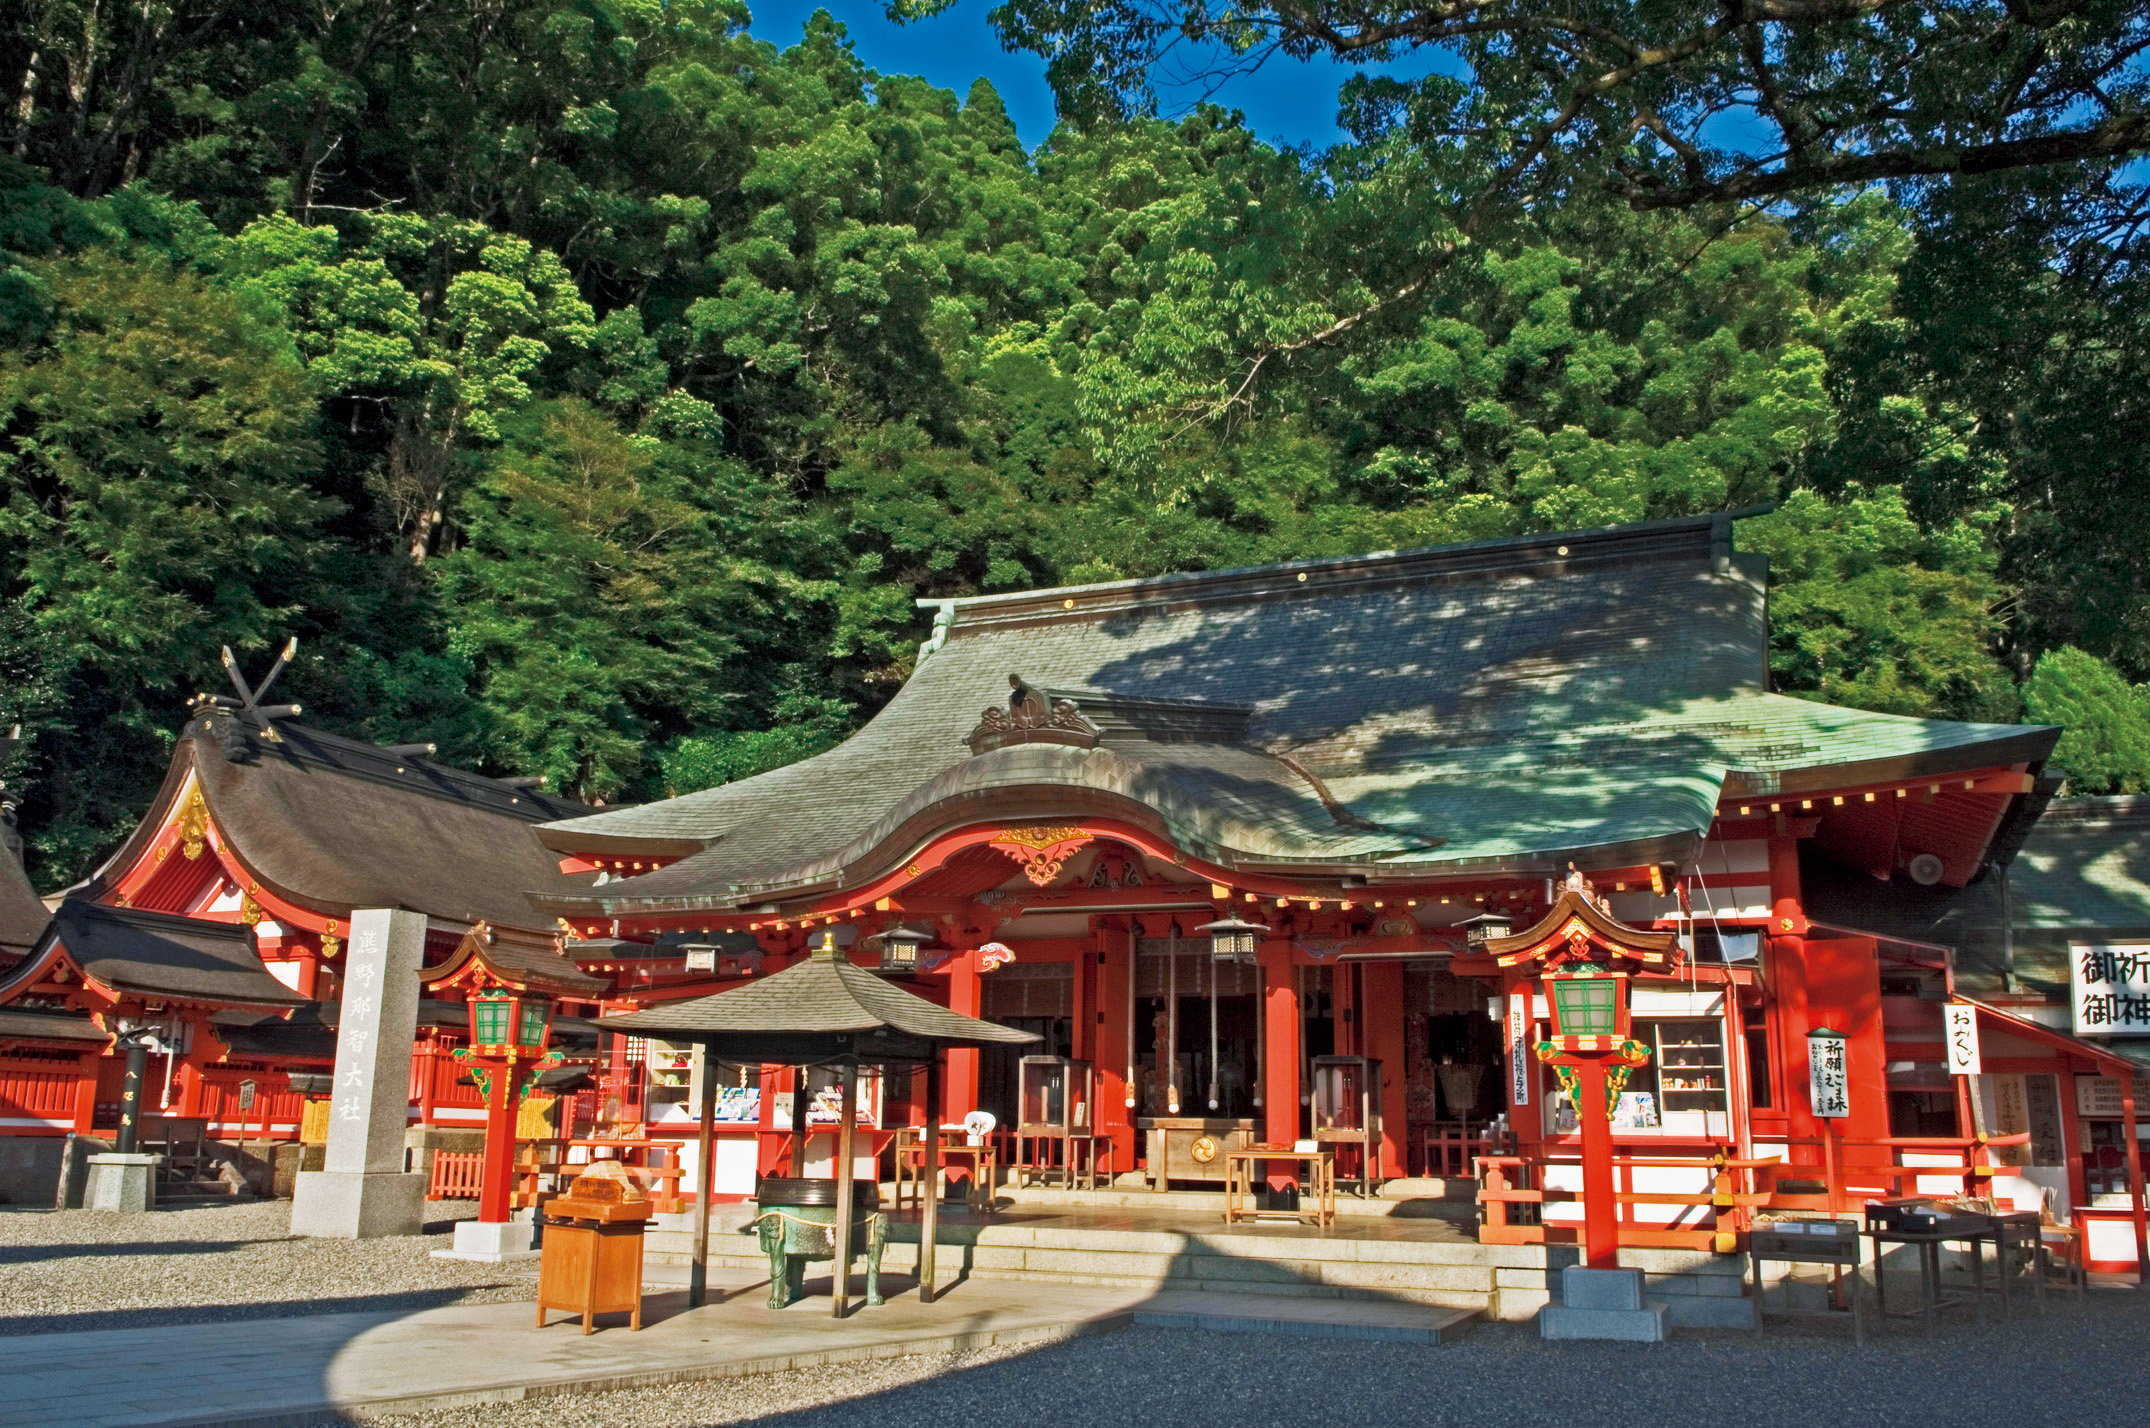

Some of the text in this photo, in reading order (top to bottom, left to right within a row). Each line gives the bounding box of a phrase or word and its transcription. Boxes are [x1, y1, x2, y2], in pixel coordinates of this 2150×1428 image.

[338, 929, 378, 1121] 熊野那智大社
[1953, 1010, 1973, 1067] おみくじ
